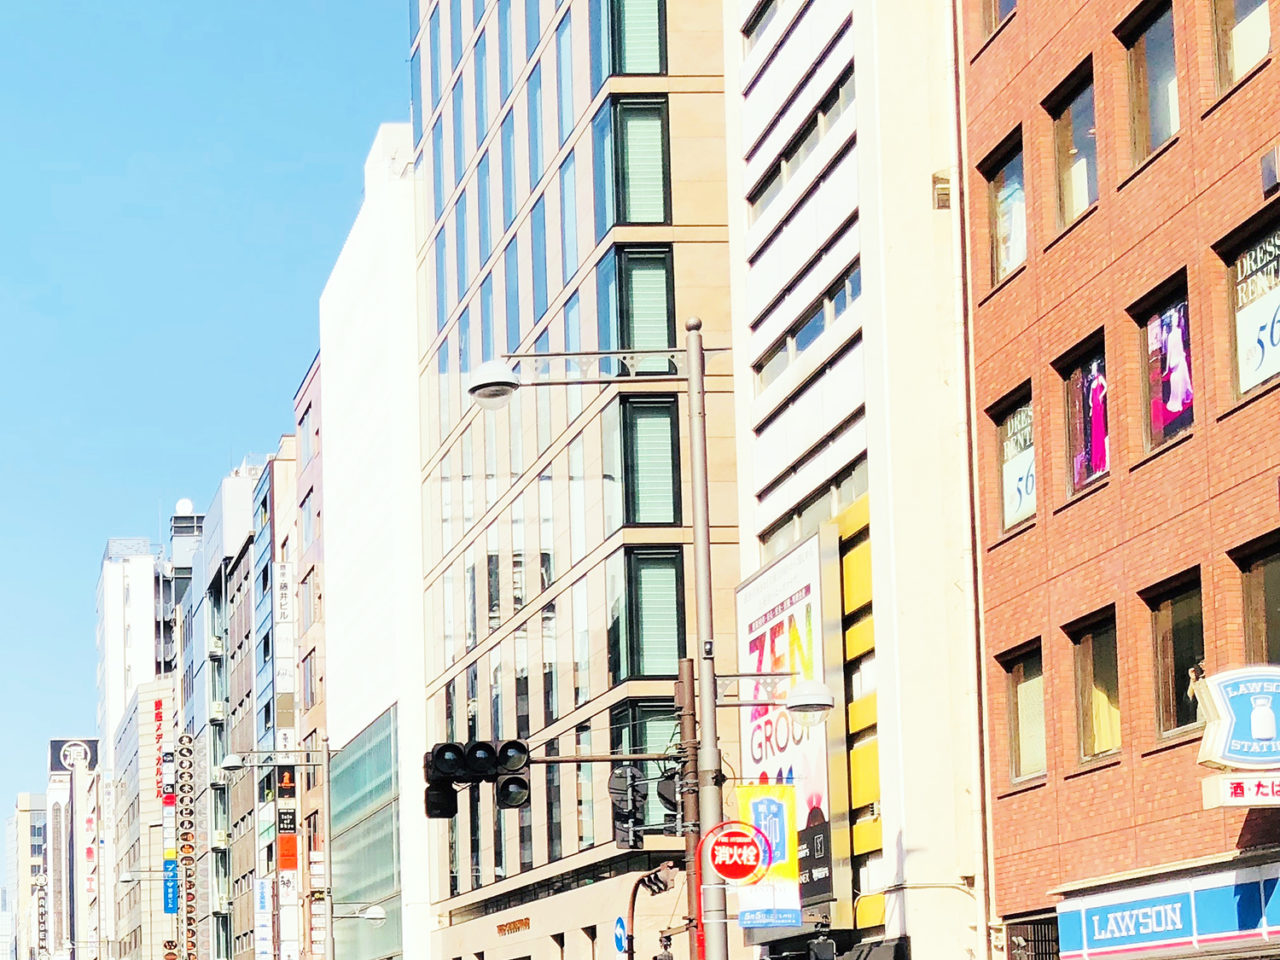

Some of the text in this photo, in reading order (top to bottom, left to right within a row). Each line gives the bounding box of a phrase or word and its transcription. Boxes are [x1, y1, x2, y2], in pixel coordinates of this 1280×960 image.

[1236, 260, 1280, 308] RENT
[749, 602, 815, 724] ZEN
[714, 845, 757, 866] 消火栓
[1092, 903, 1183, 940] LAWSON
